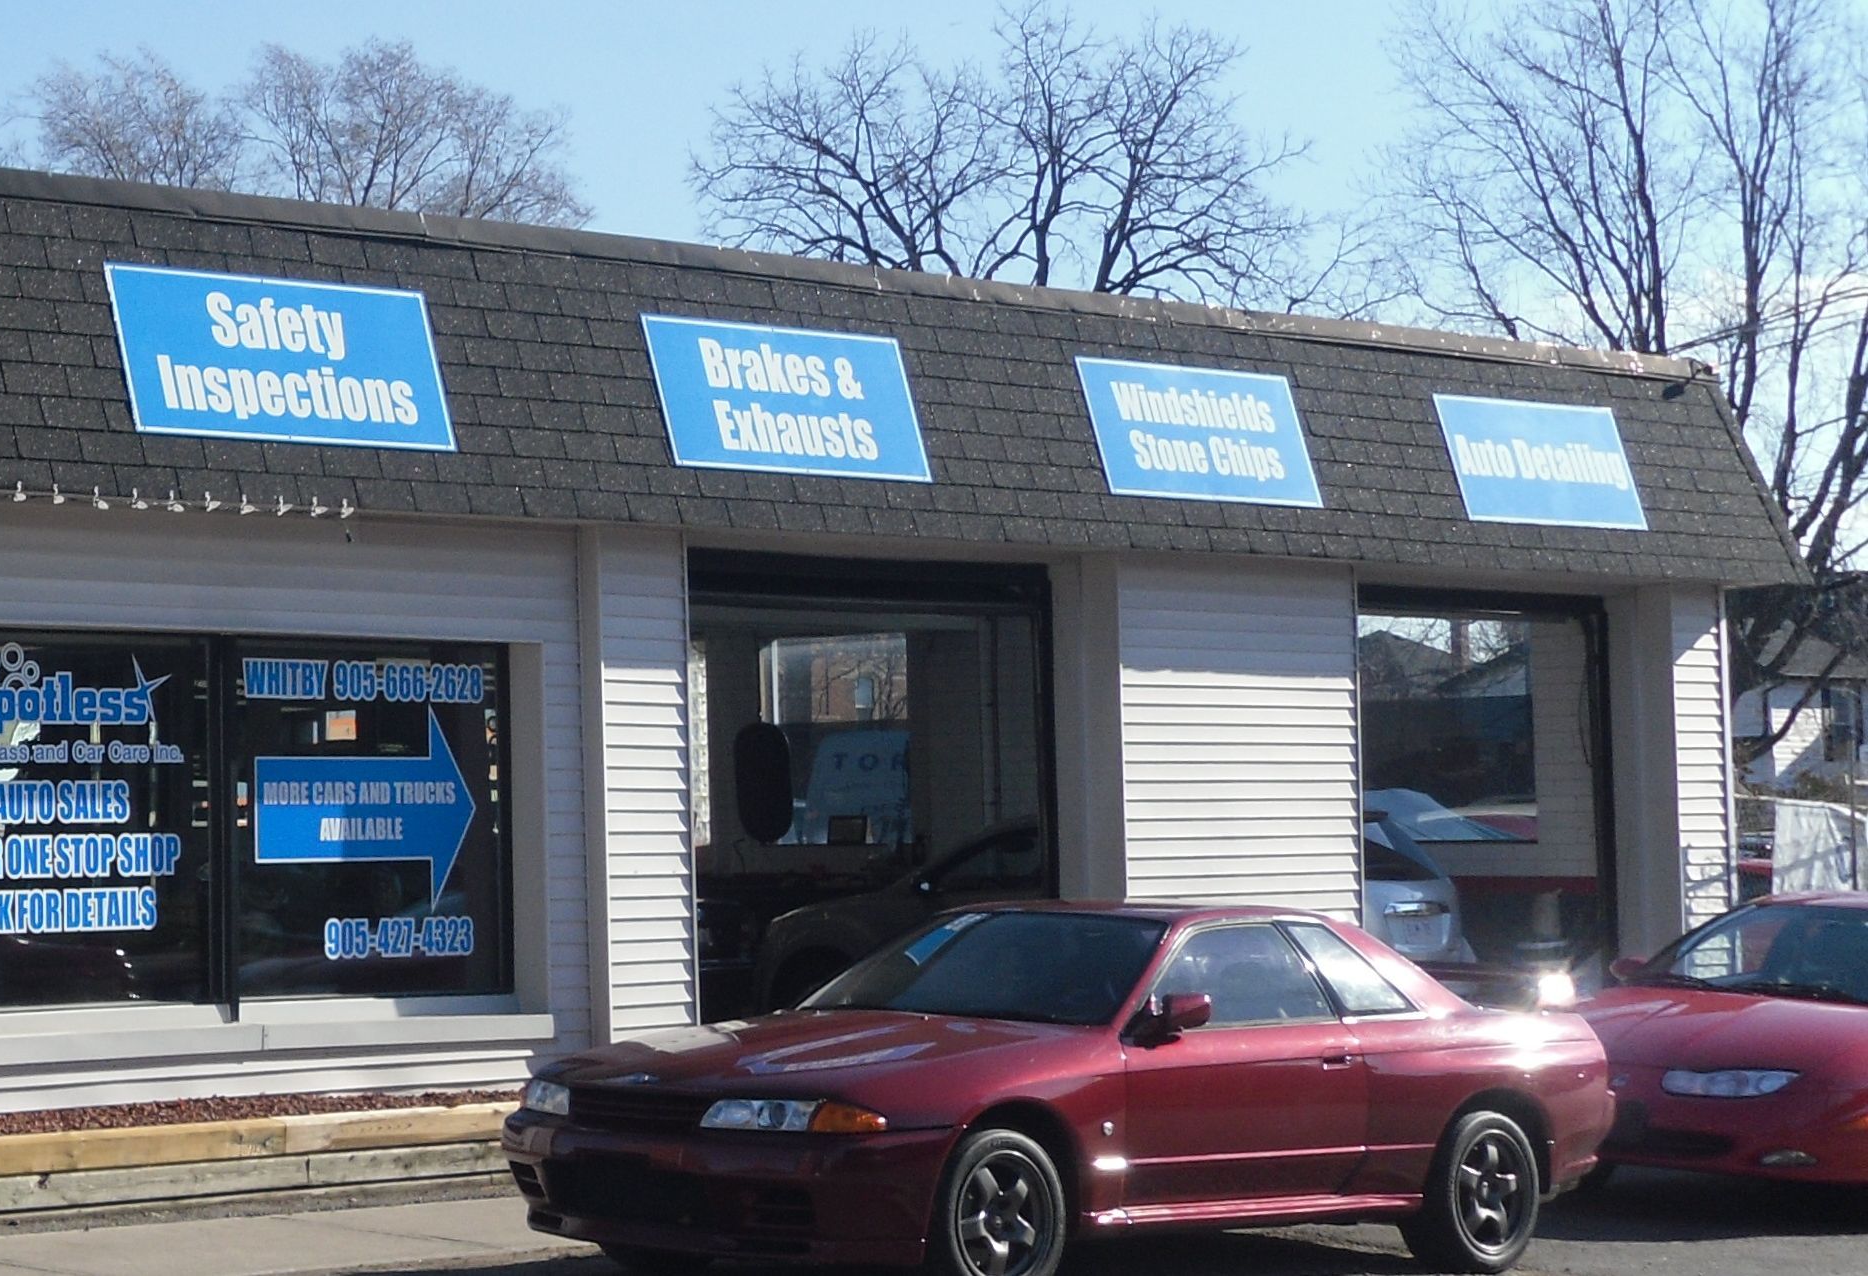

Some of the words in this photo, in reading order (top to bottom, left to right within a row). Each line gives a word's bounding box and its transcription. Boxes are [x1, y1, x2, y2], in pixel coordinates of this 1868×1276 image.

[206, 291, 345, 360] Safety
[156, 354, 419, 425] Inspections
[698, 337, 830, 397] Brakes
[834, 357, 865, 400] &
[713, 400, 879, 460] Exhausts
[1109, 381, 1276, 433] Windshields
[1129, 429, 1209, 474] Stone
[1208, 435, 1285, 482] Chips
[1454, 434, 1516, 478] Auto
[1511, 438, 1629, 491] Detailing
[242, 657, 329, 700] WHITBY
[333, 660, 485, 703] 905-666-2628
[32, 740, 68, 763] and
[72, 740, 104, 763] Car
[107, 741, 150, 763] Care
[152, 741, 185, 764] Inc.
[57, 780, 131, 824] SALES
[263, 782, 310, 806] MORE
[312, 781, 357, 805] CARS
[359, 781, 391, 805] AND
[394, 781, 456, 805] TRUCKS
[320, 817, 404, 841] AVAILABLE
[4, 834, 54, 880] ONE
[53, 834, 117, 879] STOP
[116, 833, 181, 878] SHOP
[15, 888, 63, 934] FOR
[63, 886, 158, 933] DETAILS
[324, 916, 475, 961] 905-427-4323
